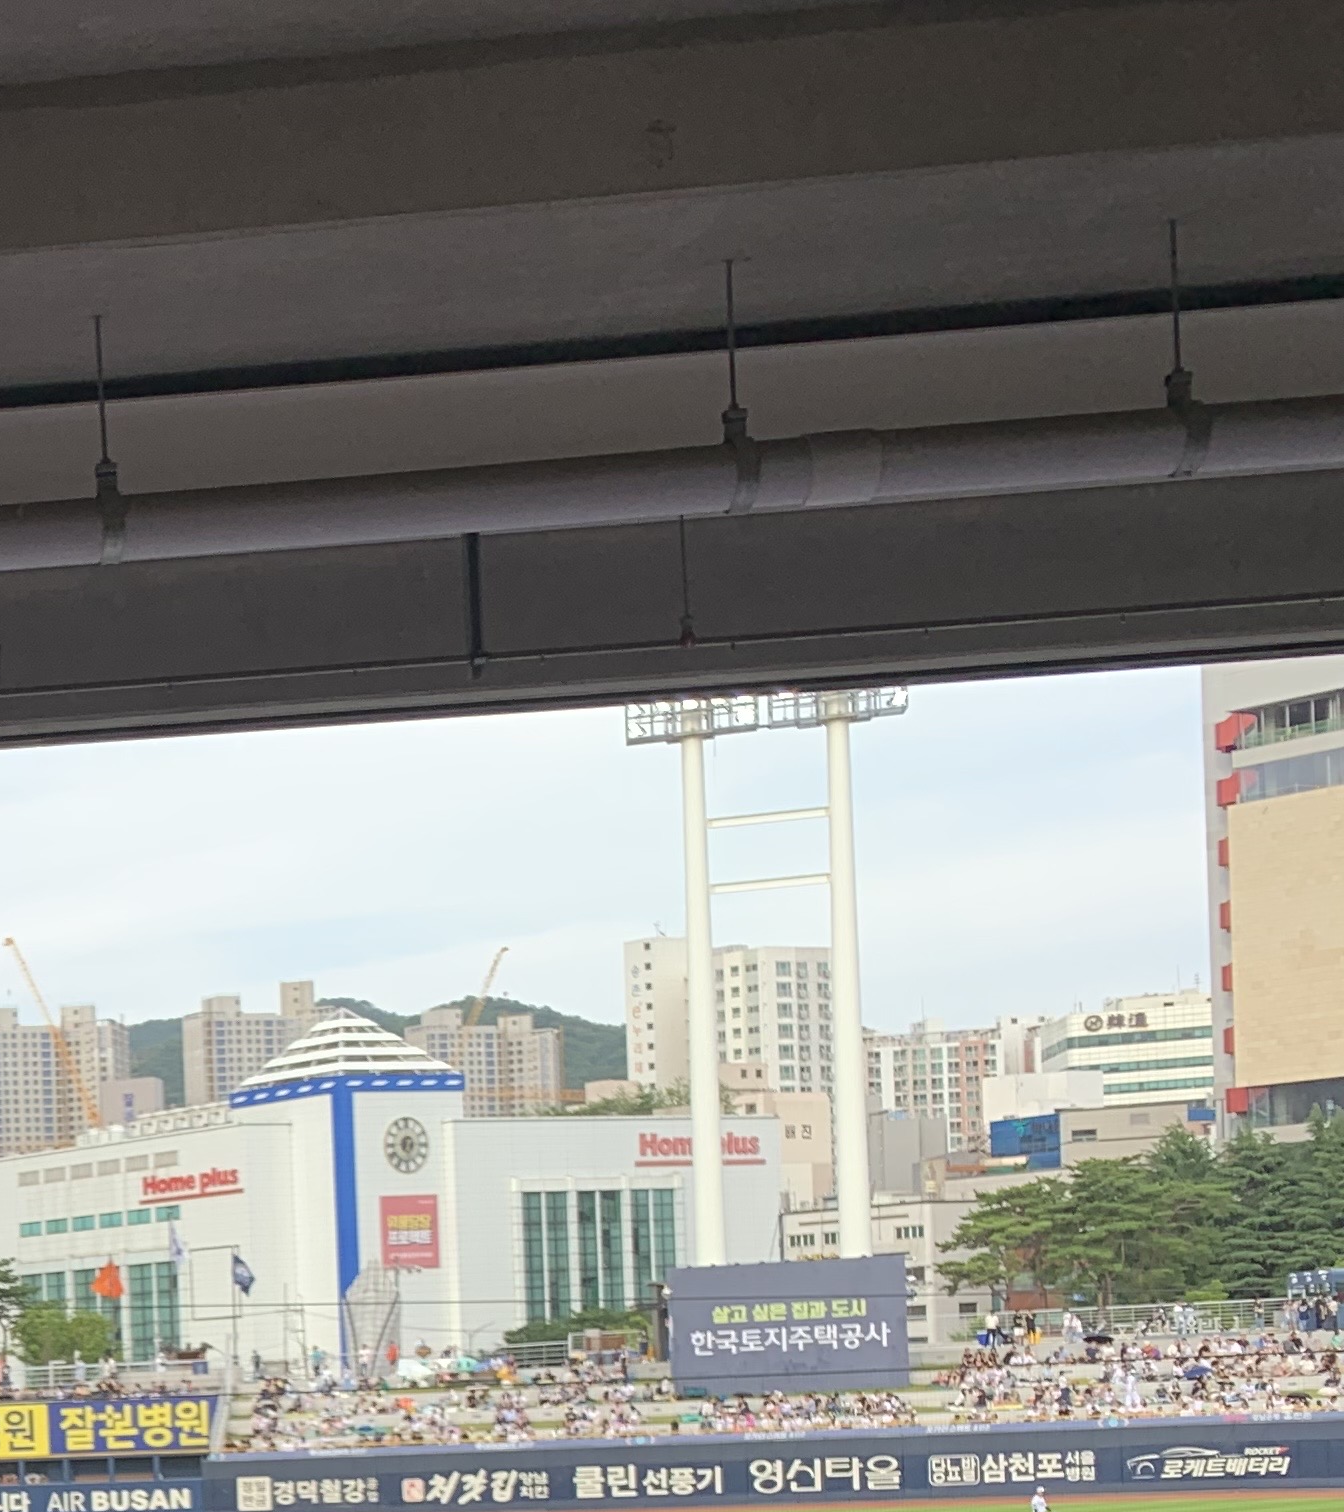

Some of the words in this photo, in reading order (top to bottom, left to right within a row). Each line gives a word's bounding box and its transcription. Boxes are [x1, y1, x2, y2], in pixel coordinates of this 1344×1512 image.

[639, 1133, 693, 1156] Hom
[142, 1174, 196, 1196] Home
[198, 1168, 238, 1193] plus
[712, 1305, 748, 1324] 살고
[752, 1302, 787, 1322] 싶은
[791, 1301, 827, 1320] 집과
[831, 1298, 867, 1318] 도시
[690, 1321, 892, 1357] 한국토지주택공사
[1065, 1450, 1096, 1465] 서울
[1243, 1446, 1280, 1455] ROCKET
[518, 1471, 549, 1485] 양념
[749, 1454, 902, 1494] 영신타올
[931, 1457, 978, 1484] 당뇨발
[980, 1451, 1065, 1484] 삼천포
[1065, 1466, 1096, 1482] 병원
[1160, 1456, 1290, 1479] 로케트배터리
[273, 1478, 366, 1505] 경덕철강
[519, 1485, 549, 1499] 치킨
[642, 1464, 724, 1496] 선풍기
[46, 1491, 87, 1512] AIR
[91, 1488, 192, 1512] BUSAN
